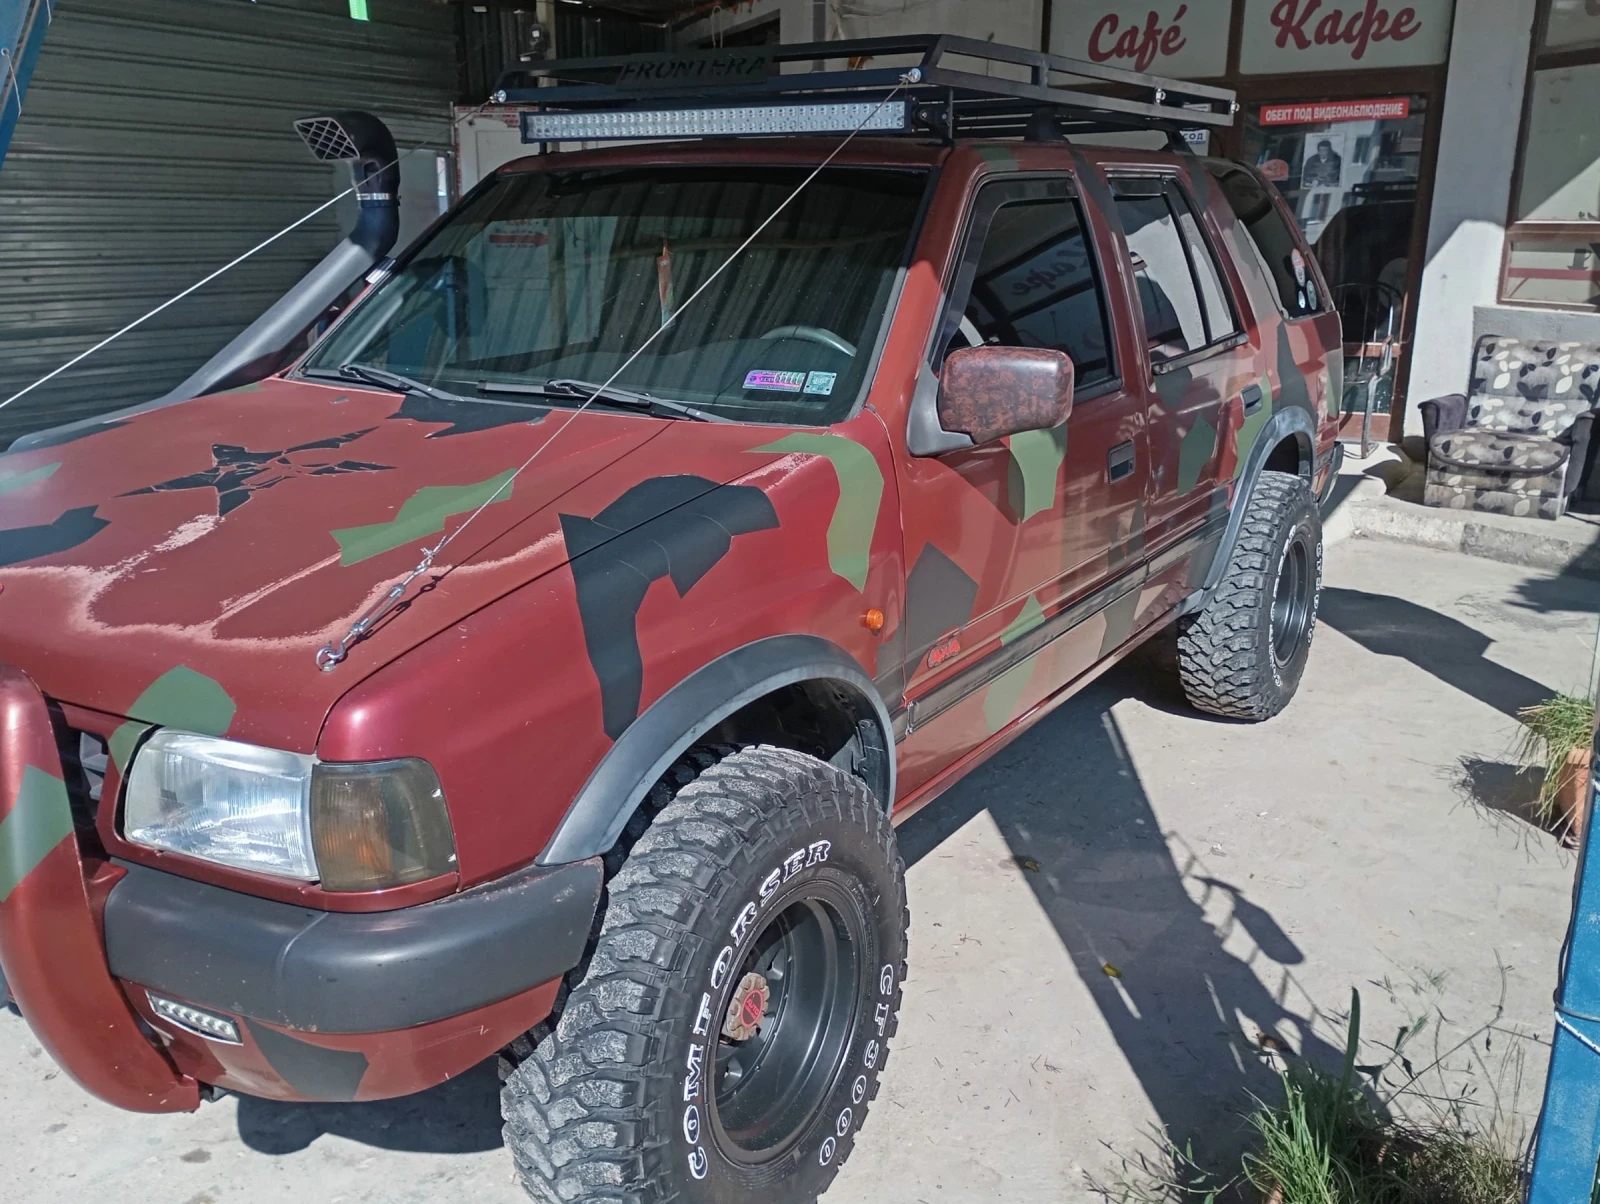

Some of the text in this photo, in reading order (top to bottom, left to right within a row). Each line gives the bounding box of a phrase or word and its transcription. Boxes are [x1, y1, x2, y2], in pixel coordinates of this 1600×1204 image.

[1087, 4, 1188, 73] Café
[1270, 0, 1422, 60] Кафе
[620, 55, 767, 81] FRONTERA
[1265, 103, 1404, 122] ОБЕКТ ПОД ВИДЕОНАБЛЮДЕНИЕ
[683, 840, 832, 1180] COMFORSER
[818, 964, 894, 1167] CF3000
